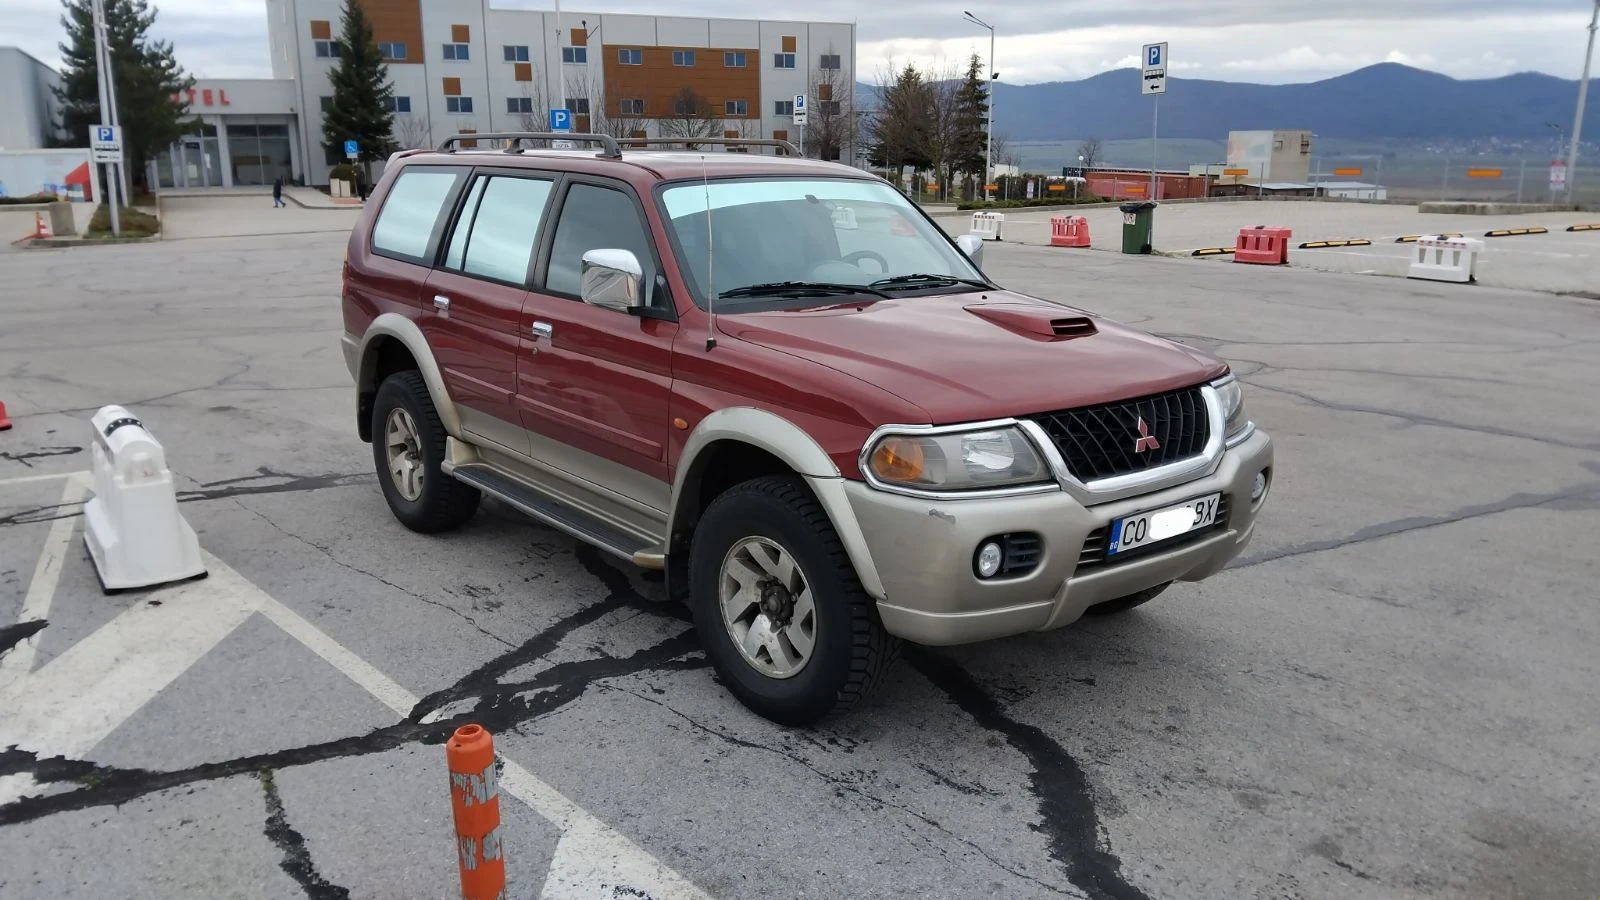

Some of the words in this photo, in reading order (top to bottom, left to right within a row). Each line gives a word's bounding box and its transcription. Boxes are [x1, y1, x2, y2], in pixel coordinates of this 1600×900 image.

[1150, 47, 1158, 65] P
[797, 96, 803, 107] P
[555, 111, 567, 127] P
[100, 128, 110, 140] P
[1122, 517, 1147, 547] CO
